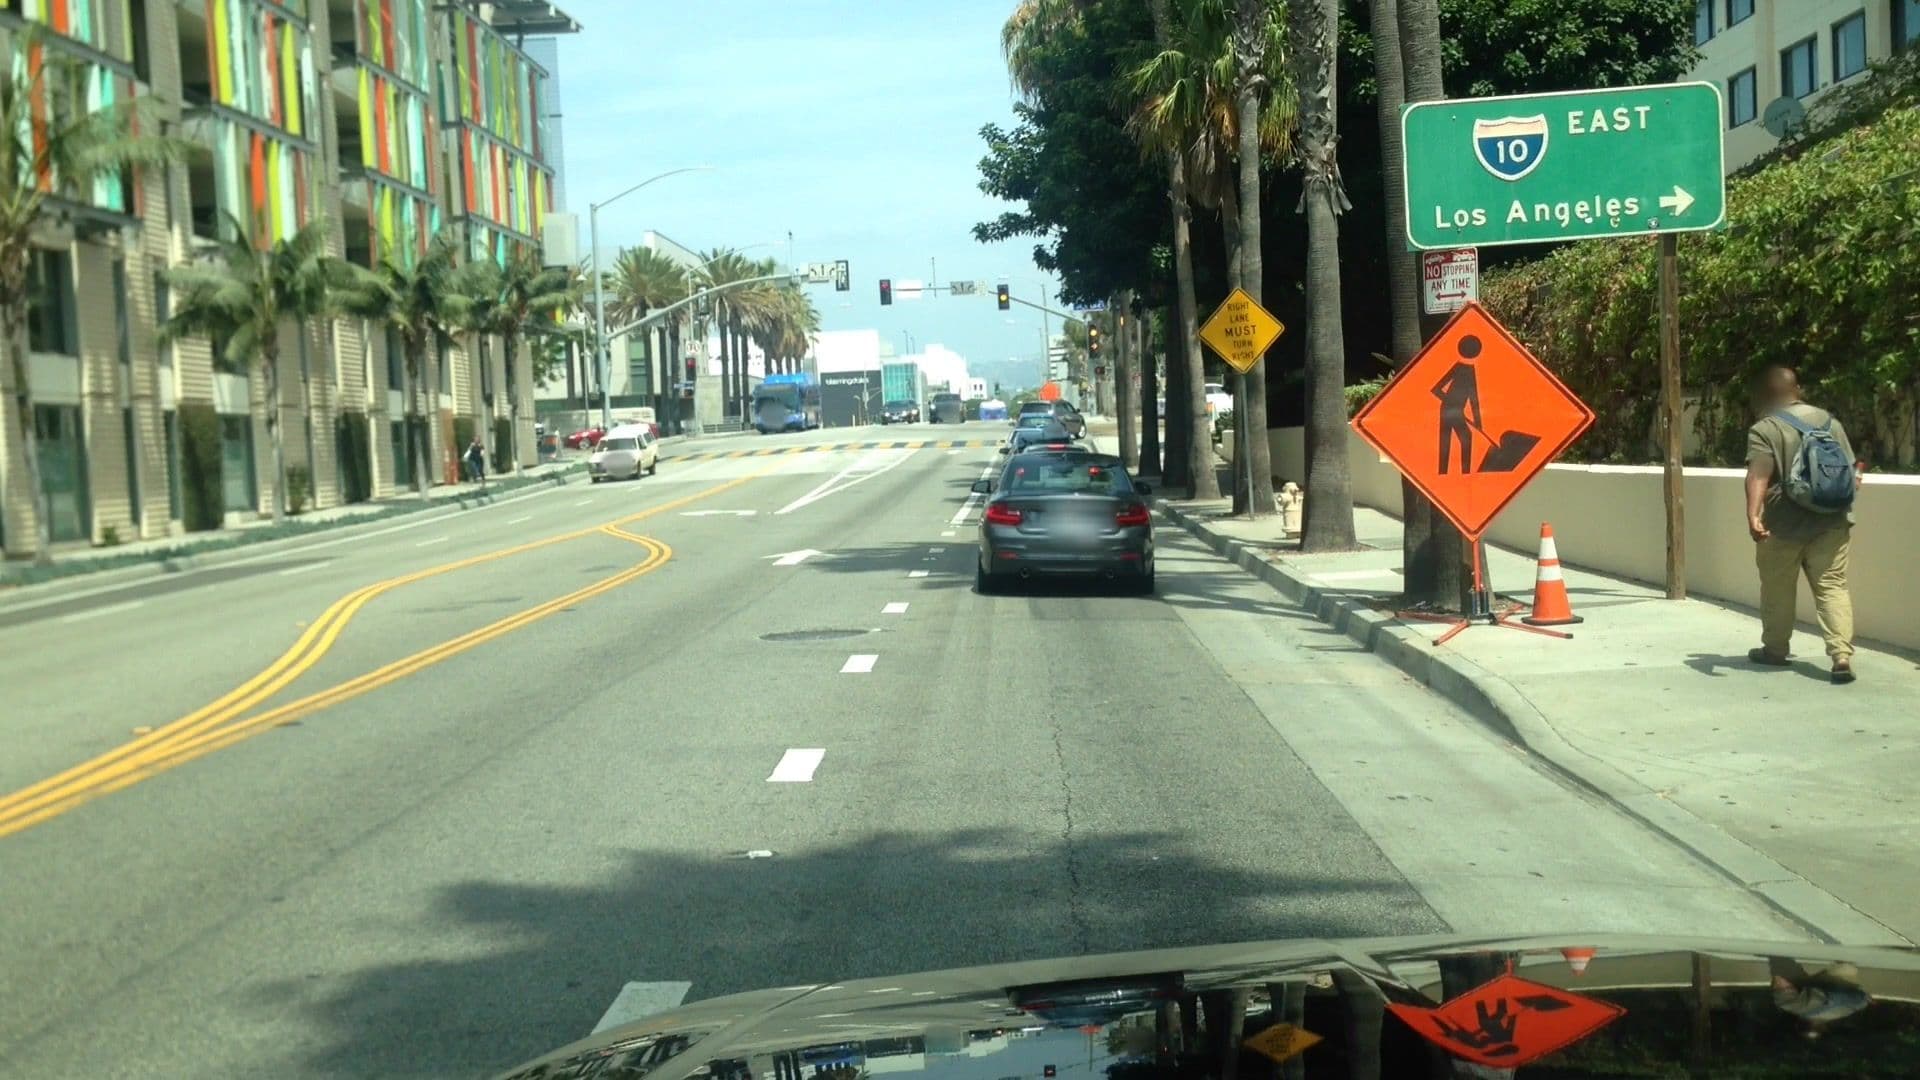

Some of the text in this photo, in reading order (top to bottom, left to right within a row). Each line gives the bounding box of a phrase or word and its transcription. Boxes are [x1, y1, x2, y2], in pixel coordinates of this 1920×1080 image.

[1569, 106, 1650, 134] EAST
[1497, 139, 1528, 164] 10
[1435, 195, 1640, 229] Los Angeles
[1426, 263, 1474, 278] NO STOPPING
[1432, 277, 1471, 290] ANY TIME
[1227, 302, 1249, 312] RIGHT
[1230, 313, 1250, 323] LANE
[1225, 325, 1257, 337] MUST
[1233, 340, 1253, 349] TURN
[1232, 351, 1254, 361] RIGHT
